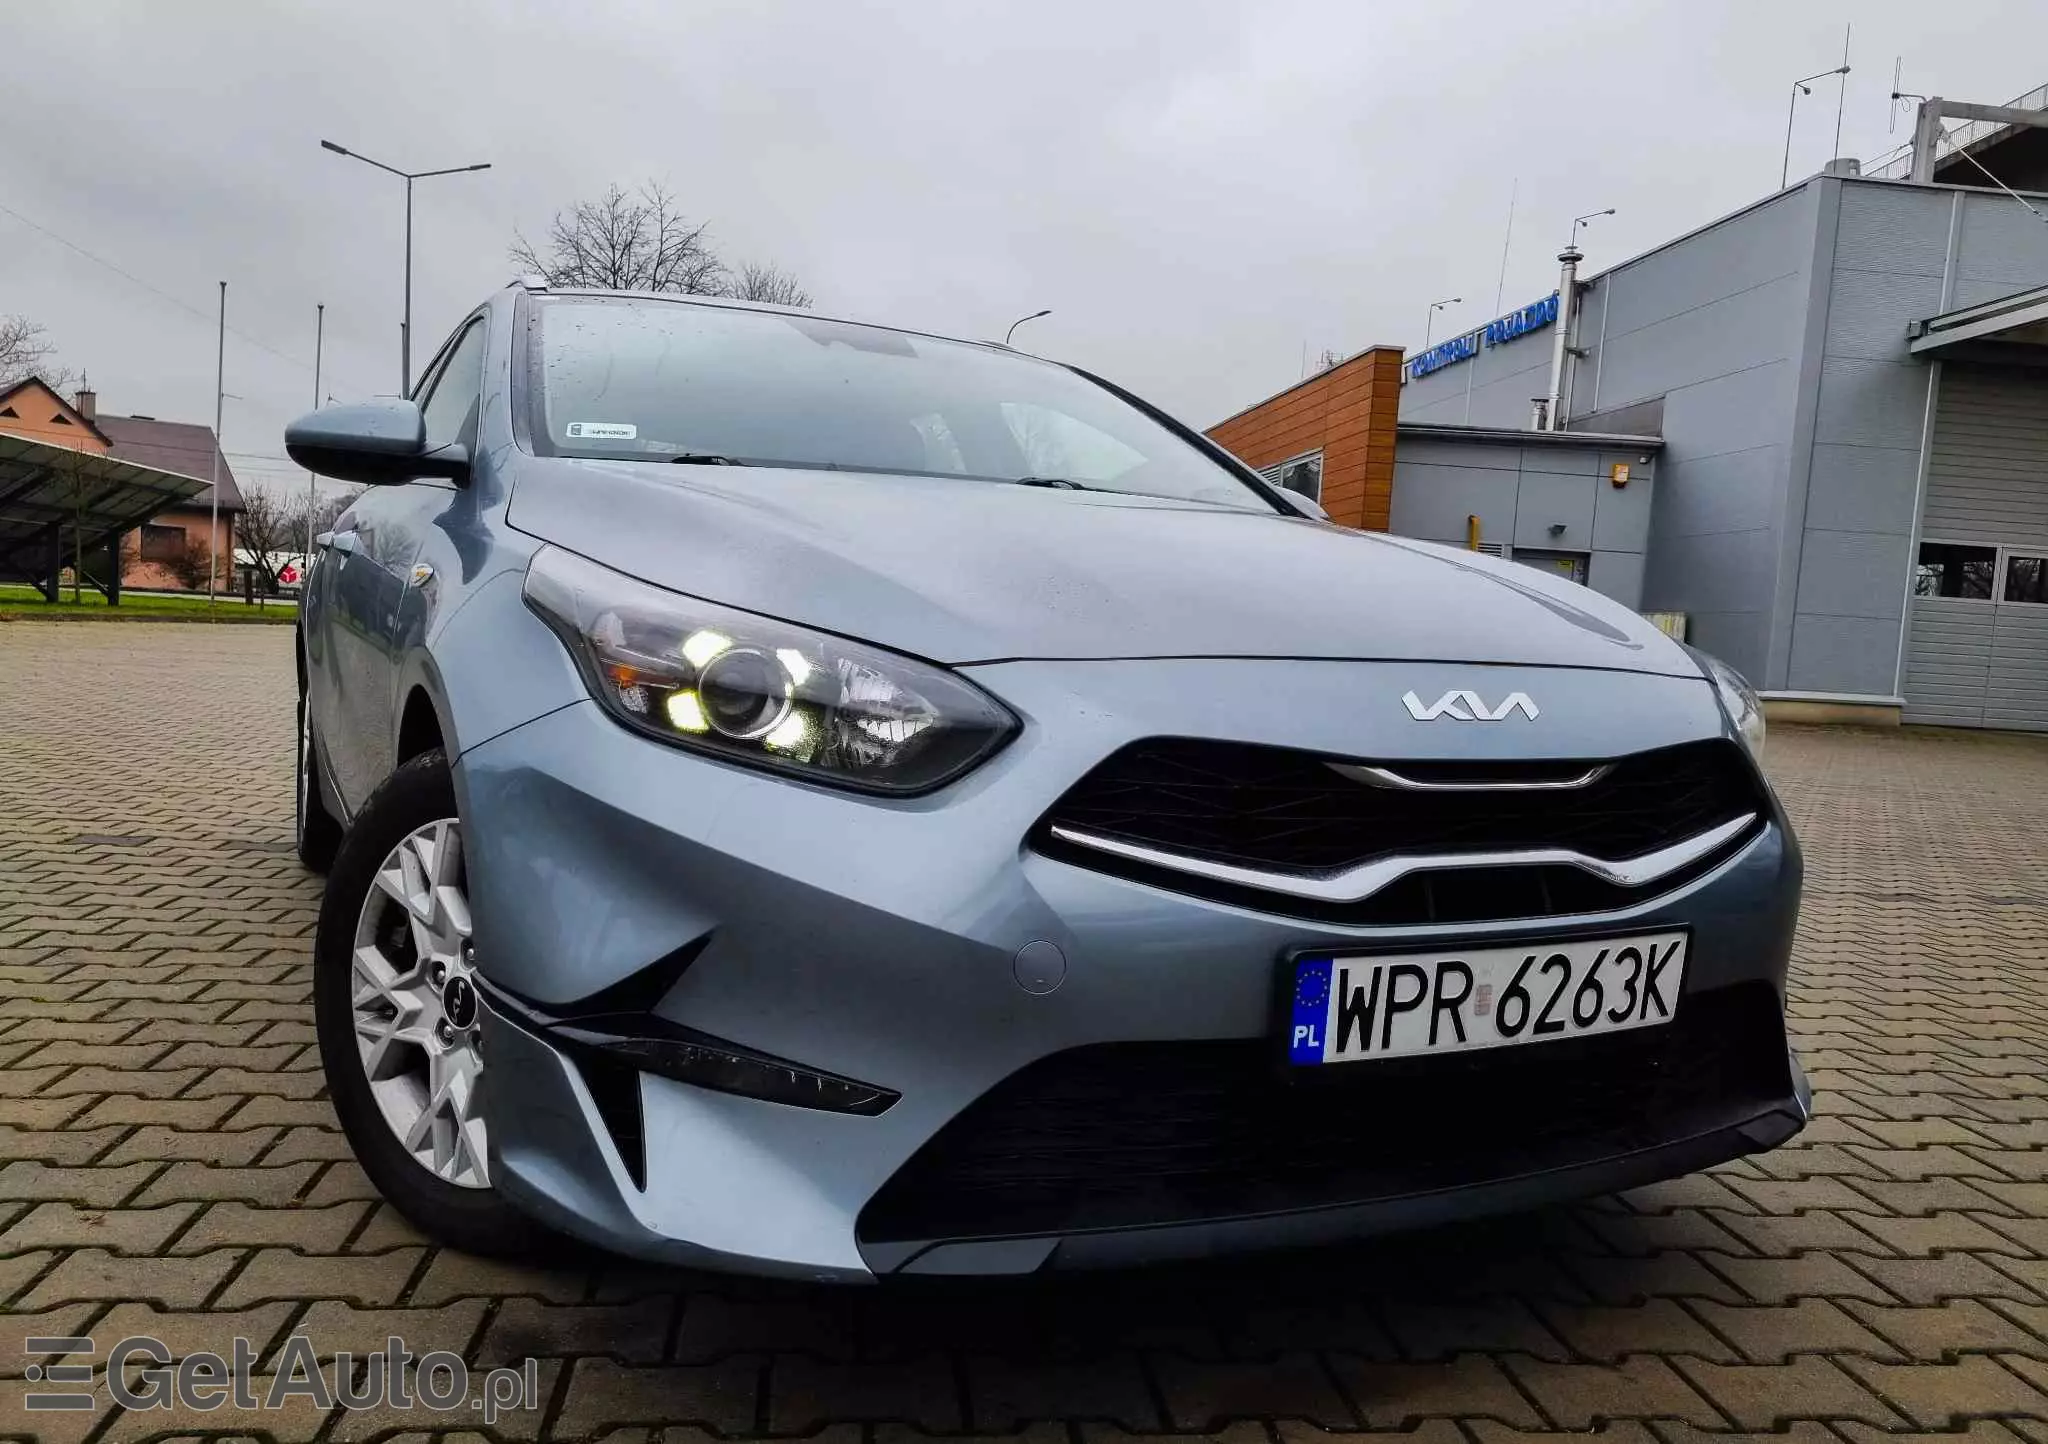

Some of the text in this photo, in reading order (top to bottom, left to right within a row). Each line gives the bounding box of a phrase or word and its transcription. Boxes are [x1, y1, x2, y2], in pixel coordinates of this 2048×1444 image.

[1401, 690, 1540, 721] KIA
[1335, 940, 1681, 1053] WPR 6263K
[1293, 1025, 1319, 1049] PL
